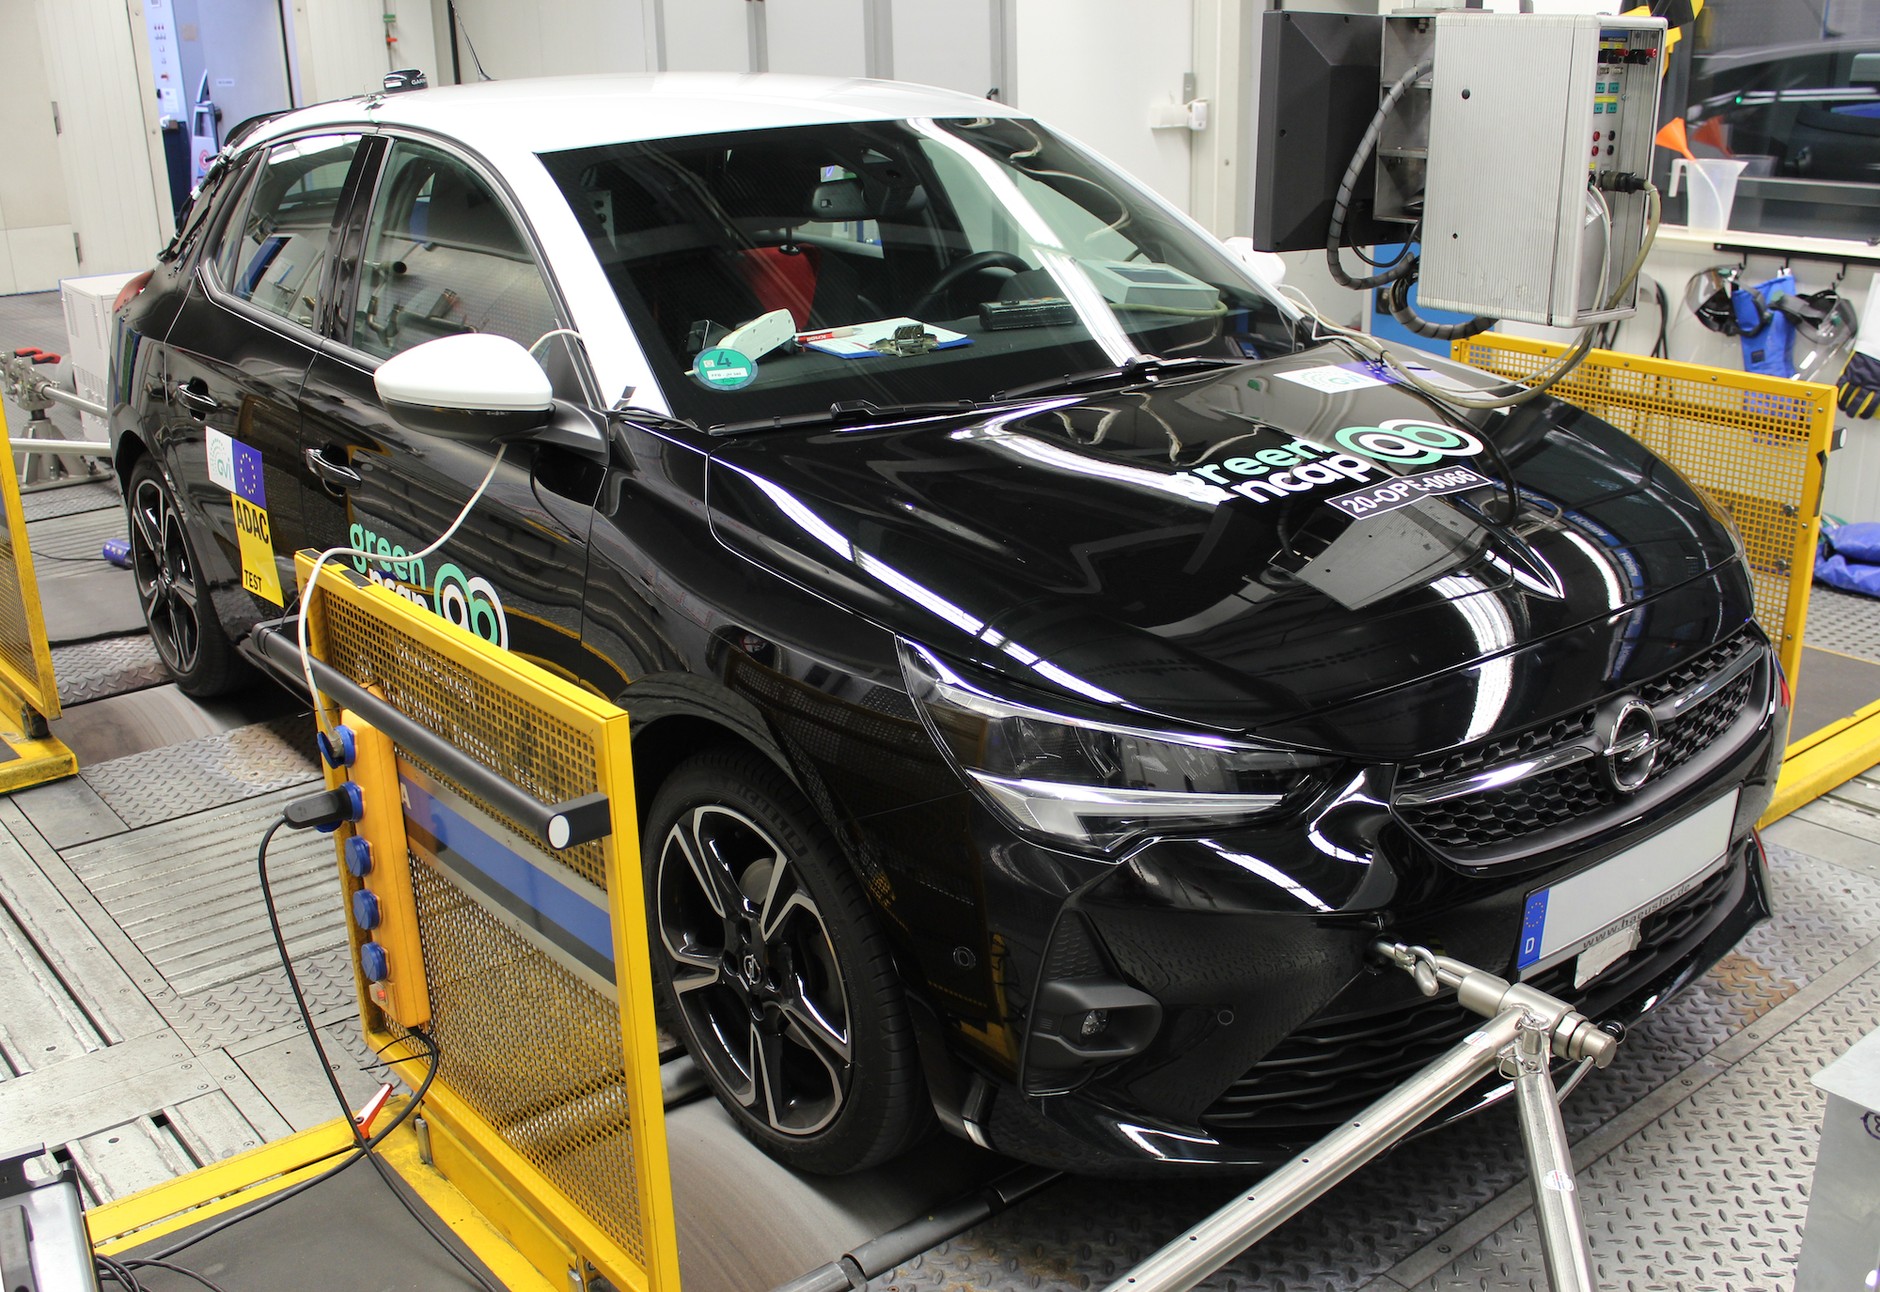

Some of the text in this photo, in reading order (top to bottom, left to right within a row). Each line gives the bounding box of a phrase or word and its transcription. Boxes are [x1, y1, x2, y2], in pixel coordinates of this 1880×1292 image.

[716, 351, 732, 367] 4
[1230, 453, 1373, 504] ncap
[1340, 468, 1479, 515] 20-OPE-0066
[235, 500, 269, 544] ADAC
[350, 523, 427, 590] green
[243, 569, 263, 592] TEST
[1583, 882, 1691, 949] www.haeusler.de
[1525, 937, 1535, 955] D
